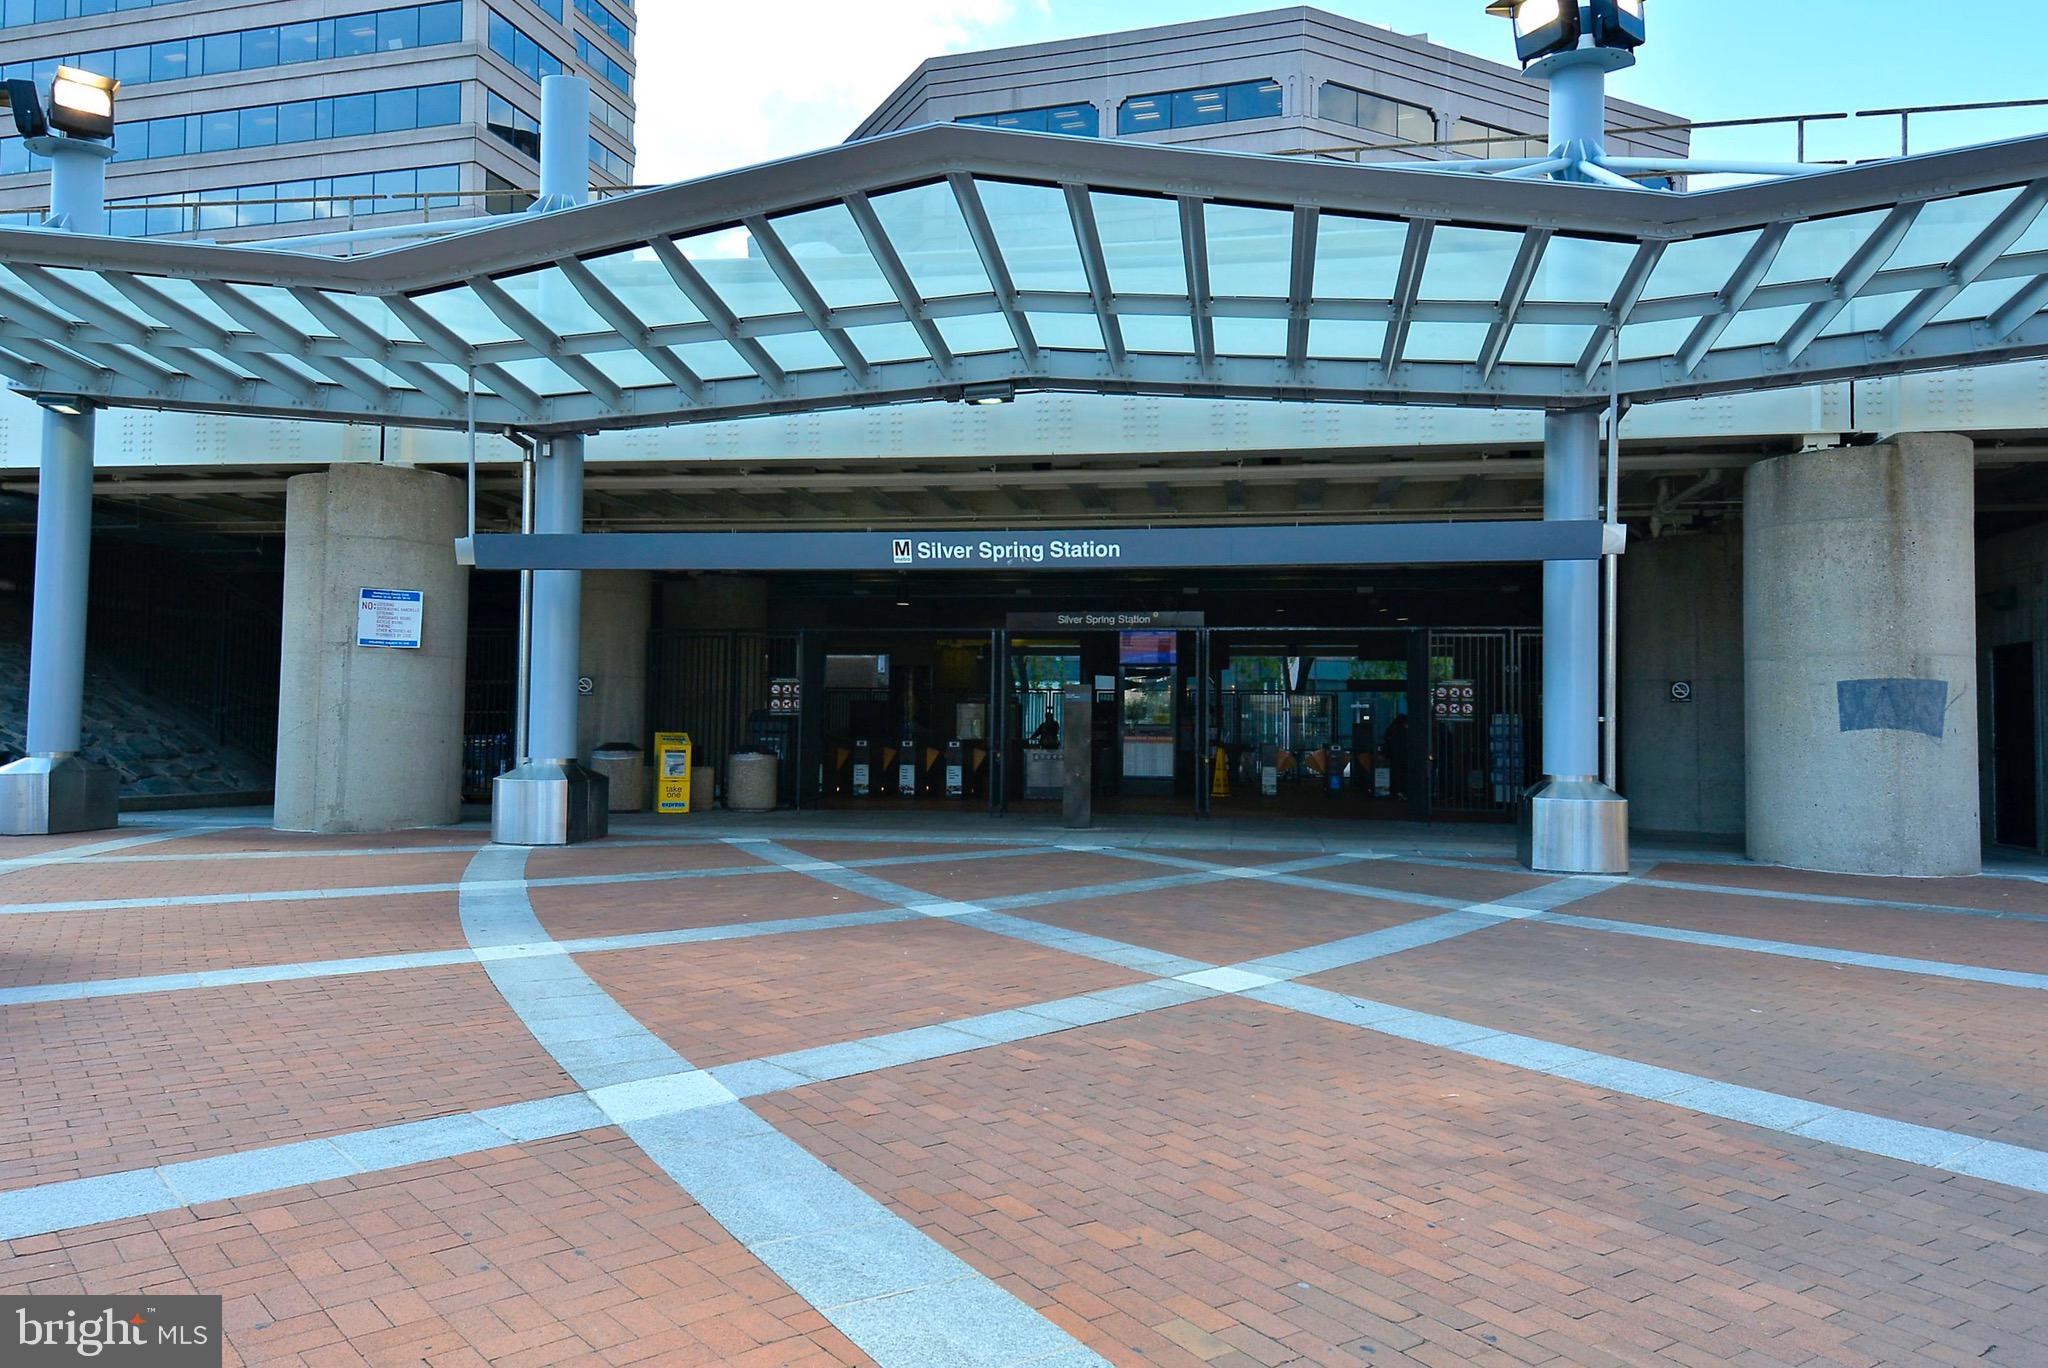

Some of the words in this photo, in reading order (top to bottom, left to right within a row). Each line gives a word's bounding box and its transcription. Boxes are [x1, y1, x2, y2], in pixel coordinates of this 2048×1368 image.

[895, 541, 910, 556] M
[917, 541, 973, 558] Silver
[979, 541, 1044, 562] Spring
[1050, 541, 1121, 558] Station
[1058, 614, 1083, 624] Silver
[1086, 615, 1115, 625] Spring
[1118, 614, 1151, 624] Station
